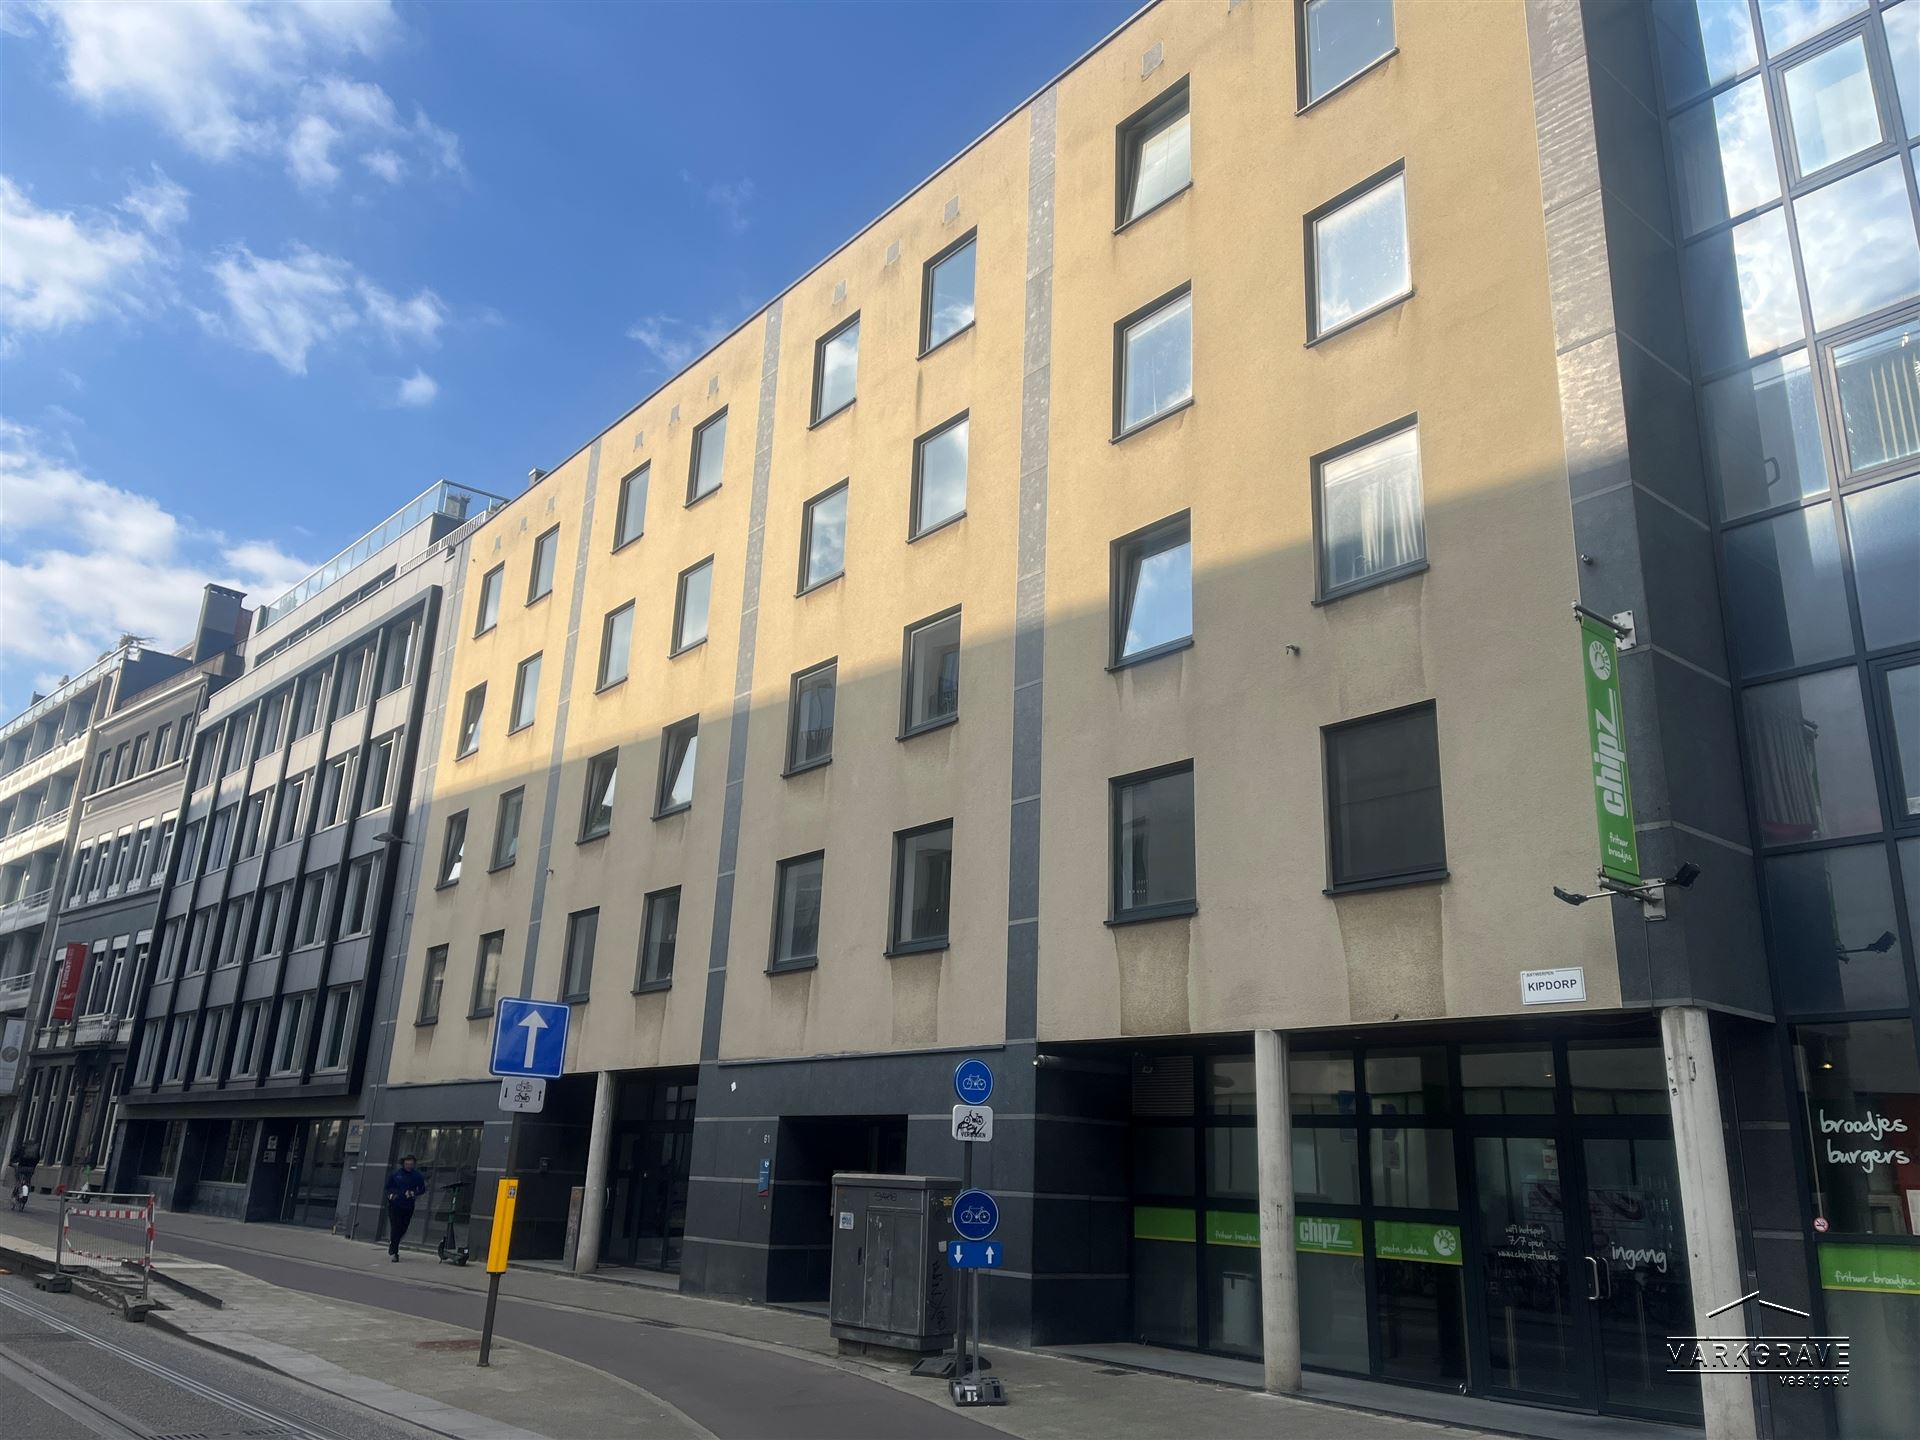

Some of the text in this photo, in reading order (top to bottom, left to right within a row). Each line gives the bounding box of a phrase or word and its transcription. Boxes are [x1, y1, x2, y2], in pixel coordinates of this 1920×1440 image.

[1593, 688, 1627, 817] chipz
[1528, 979, 1576, 991] KIPDORP
[1820, 1109, 1908, 1141] broodjes
[1827, 1139, 1911, 1174] burgers
[1299, 1217, 1352, 1249] chipz
[1507, 1235, 1527, 1248] 7/7
[1611, 1241, 1667, 1273] ingang
